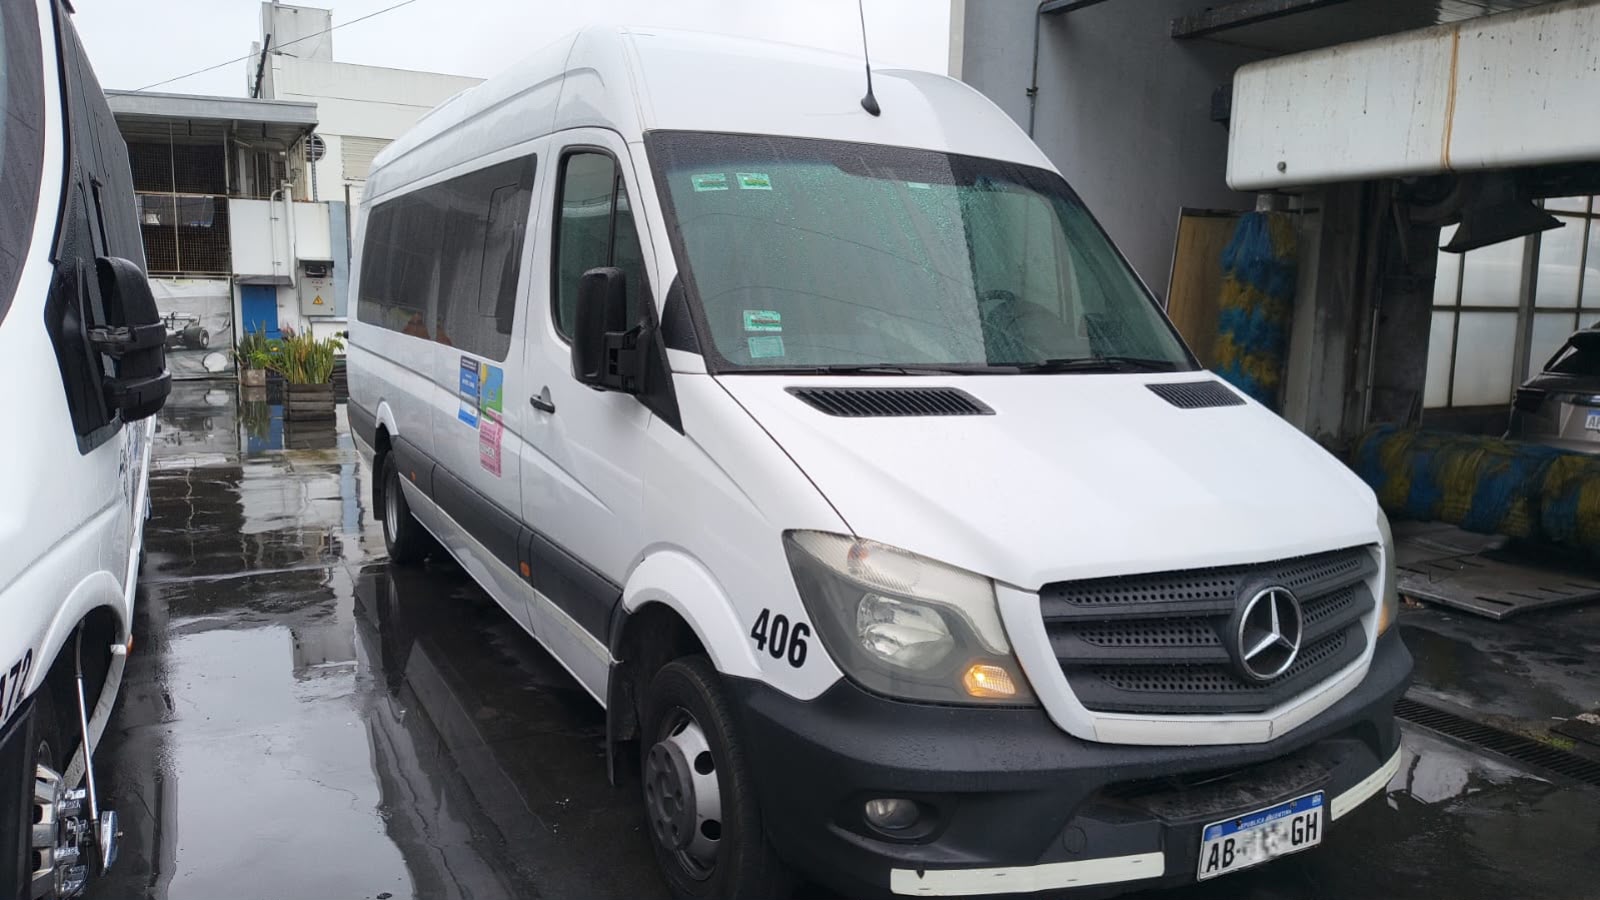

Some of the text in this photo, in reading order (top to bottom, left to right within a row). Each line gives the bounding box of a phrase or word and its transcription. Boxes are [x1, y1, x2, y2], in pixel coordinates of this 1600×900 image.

[750, 607, 811, 669] 406
[1206, 838, 1236, 873] AB
[1291, 811, 1318, 846] GH
